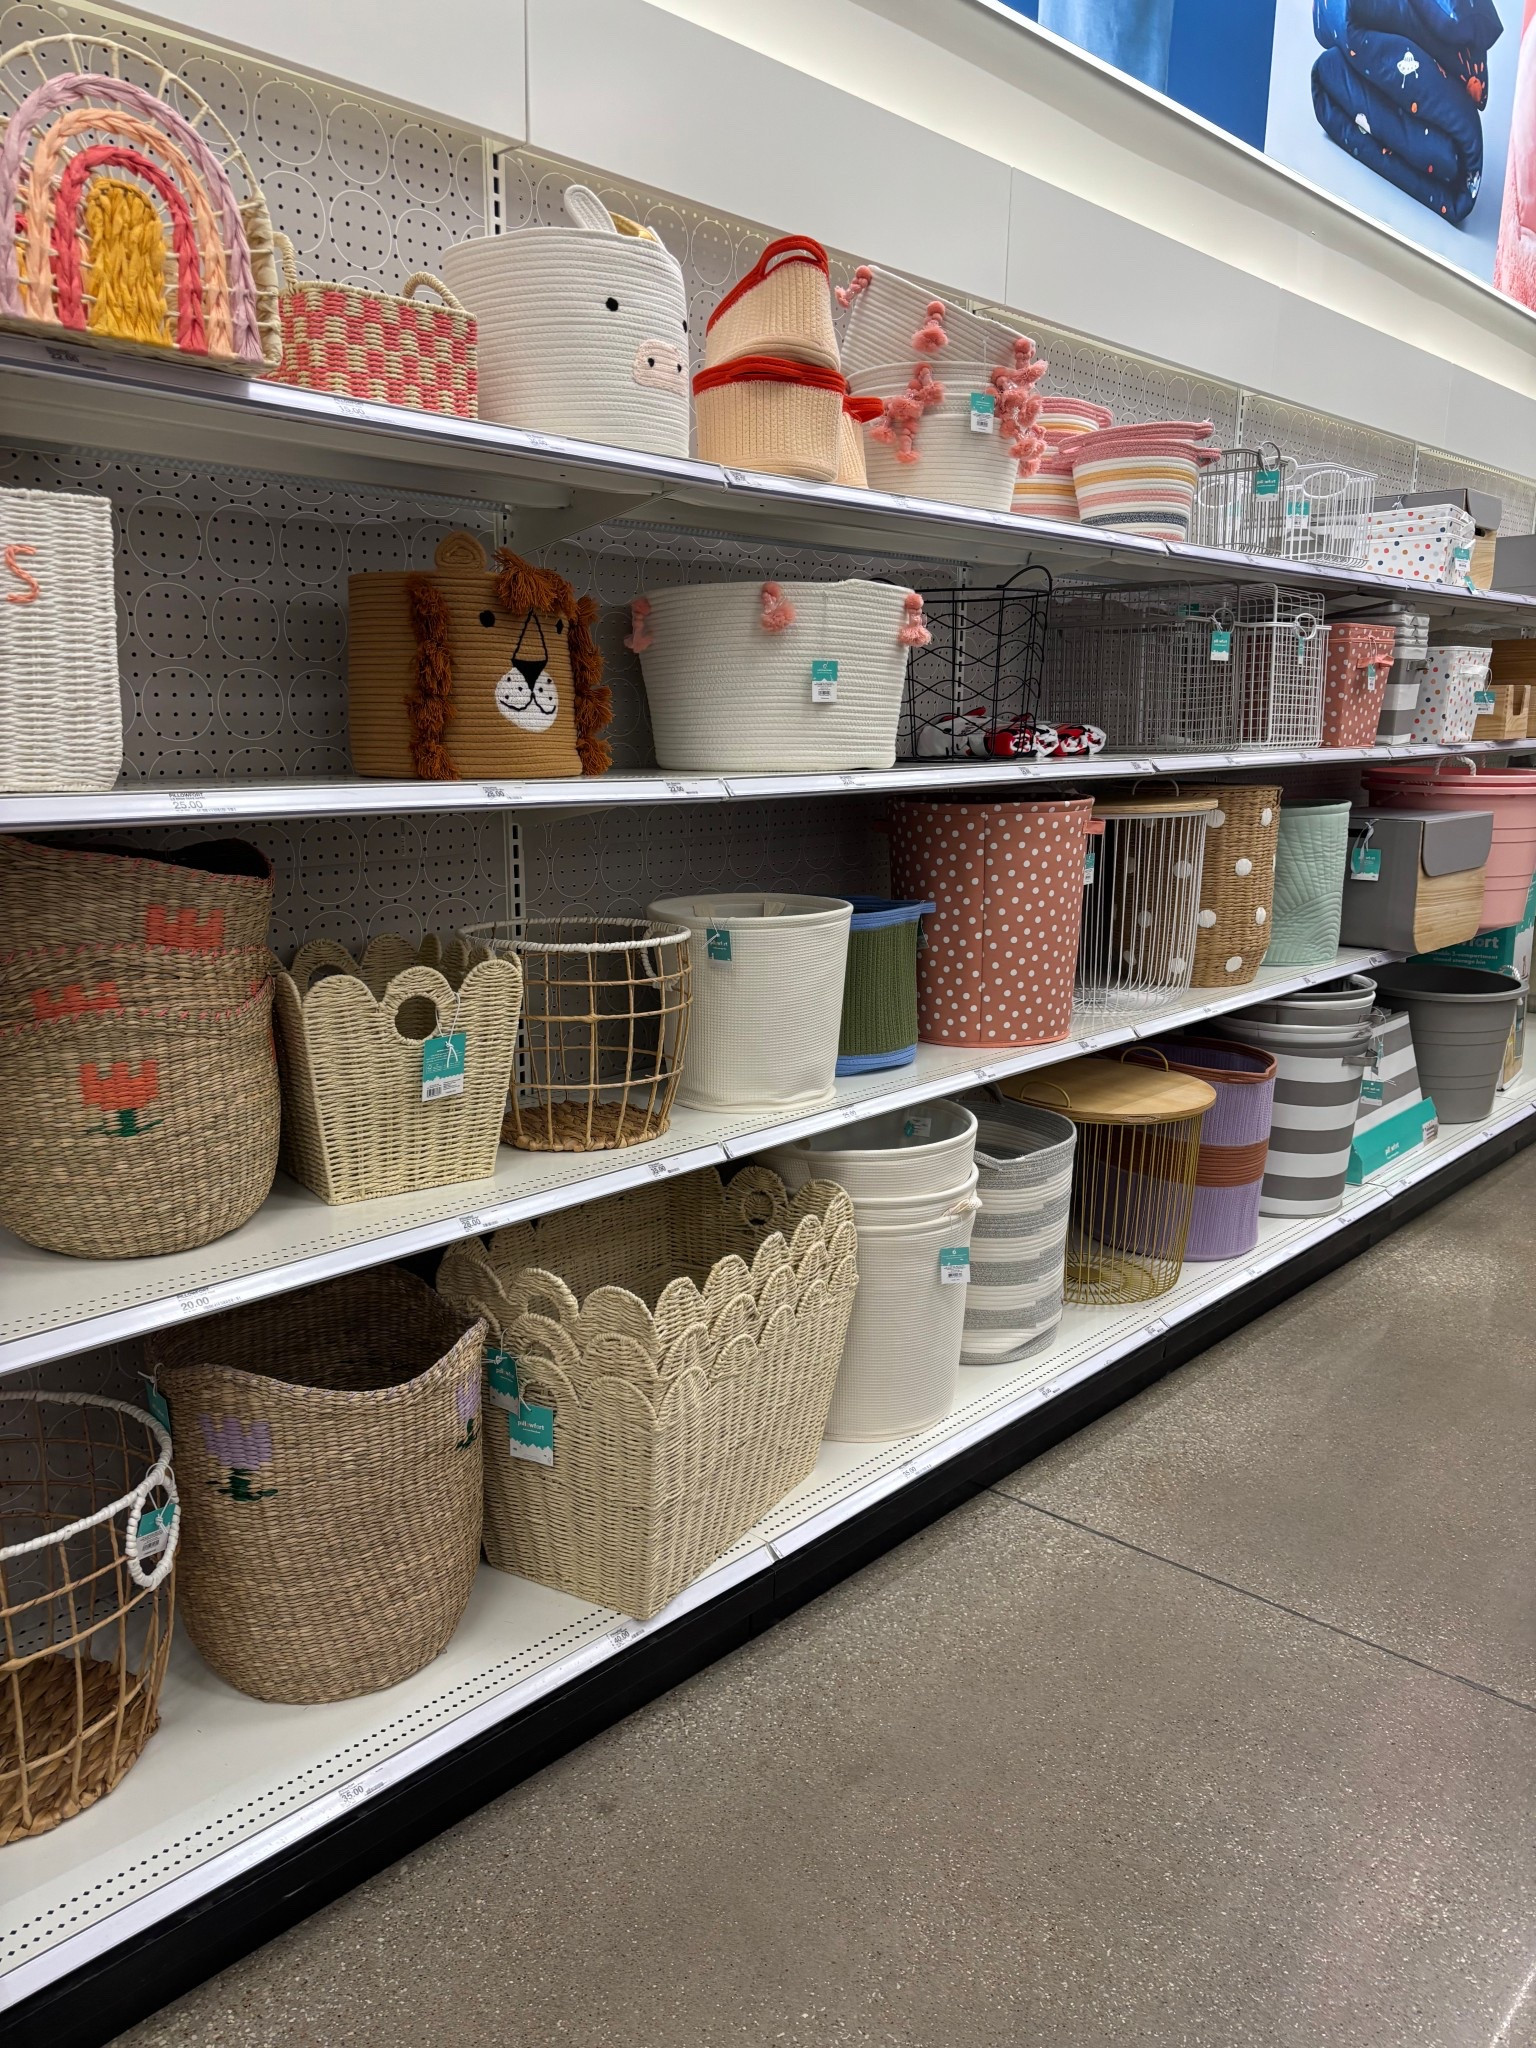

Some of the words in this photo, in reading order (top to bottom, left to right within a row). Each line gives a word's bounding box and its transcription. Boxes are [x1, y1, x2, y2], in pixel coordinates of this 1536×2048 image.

[5, 544, 41, 604] S
[173, 801, 203, 809] 25.00
[180, 1297, 209, 1311] 20.00
[614, 1630, 630, 1643] 40.00
[341, 1785, 364, 1802] 35.00
